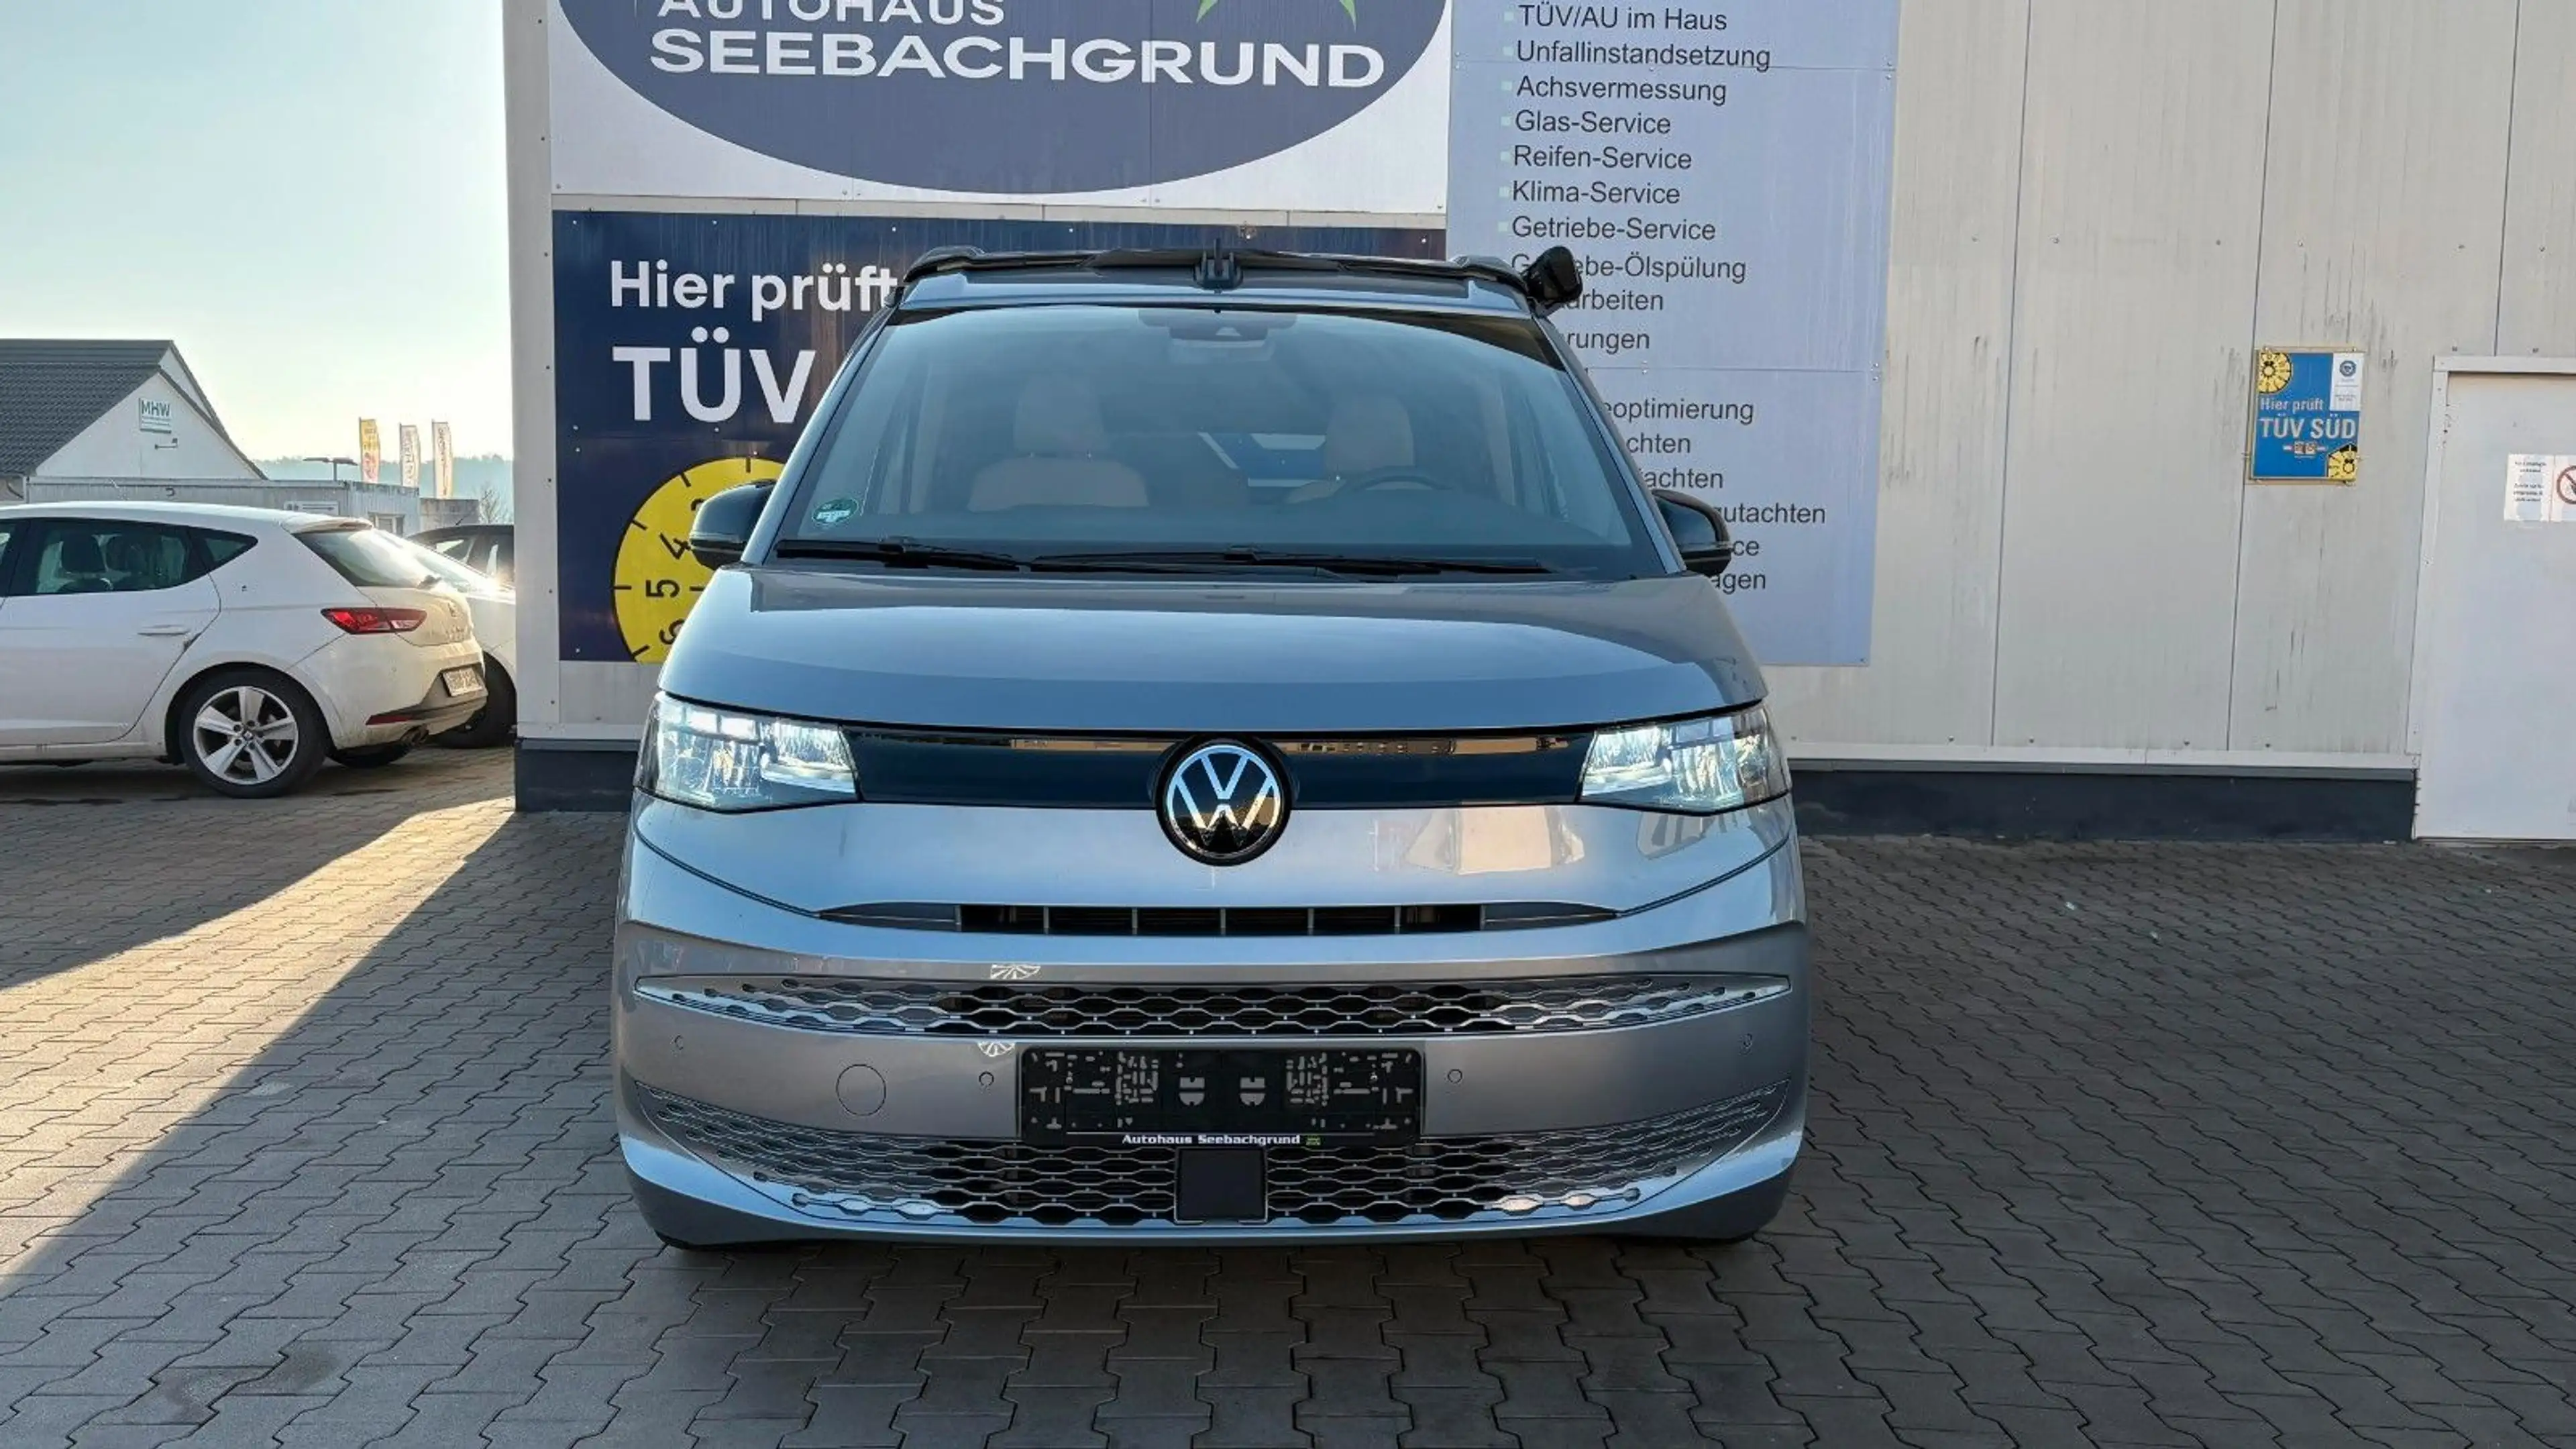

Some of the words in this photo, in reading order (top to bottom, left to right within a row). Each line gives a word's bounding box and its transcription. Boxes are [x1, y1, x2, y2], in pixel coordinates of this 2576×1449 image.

[657, 0, 1005, 25] AUTOHAUS
[1519, 1, 1617, 28] TÜV/AU
[1627, 7, 1654, 29] im
[1665, 8, 1727, 30] Haus
[650, 28, 1384, 87] SEEBACHGRUND
[1517, 40, 1770, 72] Unfallinstandsetzung
[1517, 76, 1727, 106] Achsvermessung
[1515, 111, 1671, 133] Glas-Service
[1513, 145, 1692, 170] Reifen-Service
[1512, 180, 1680, 204] Klima-Service
[1511, 215, 1716, 240] Getriebe-Service
[611, 259, 735, 309] Hier
[751, 262, 898, 322] prüft
[612, 326, 816, 423] TÜV
[142, 400, 170, 417] MHW
[2260, 396, 2289, 410] Hier
[2292, 396, 2324, 415] prüft
[2259, 413, 2305, 439] TÜV
[2310, 413, 2356, 439] SÜD
[658, 532, 692, 559] 4
[645, 579, 680, 598] 5
[1122, 1134, 1193, 1145] Autohaus
[1197, 1134, 1301, 1146] Seebachgrund
